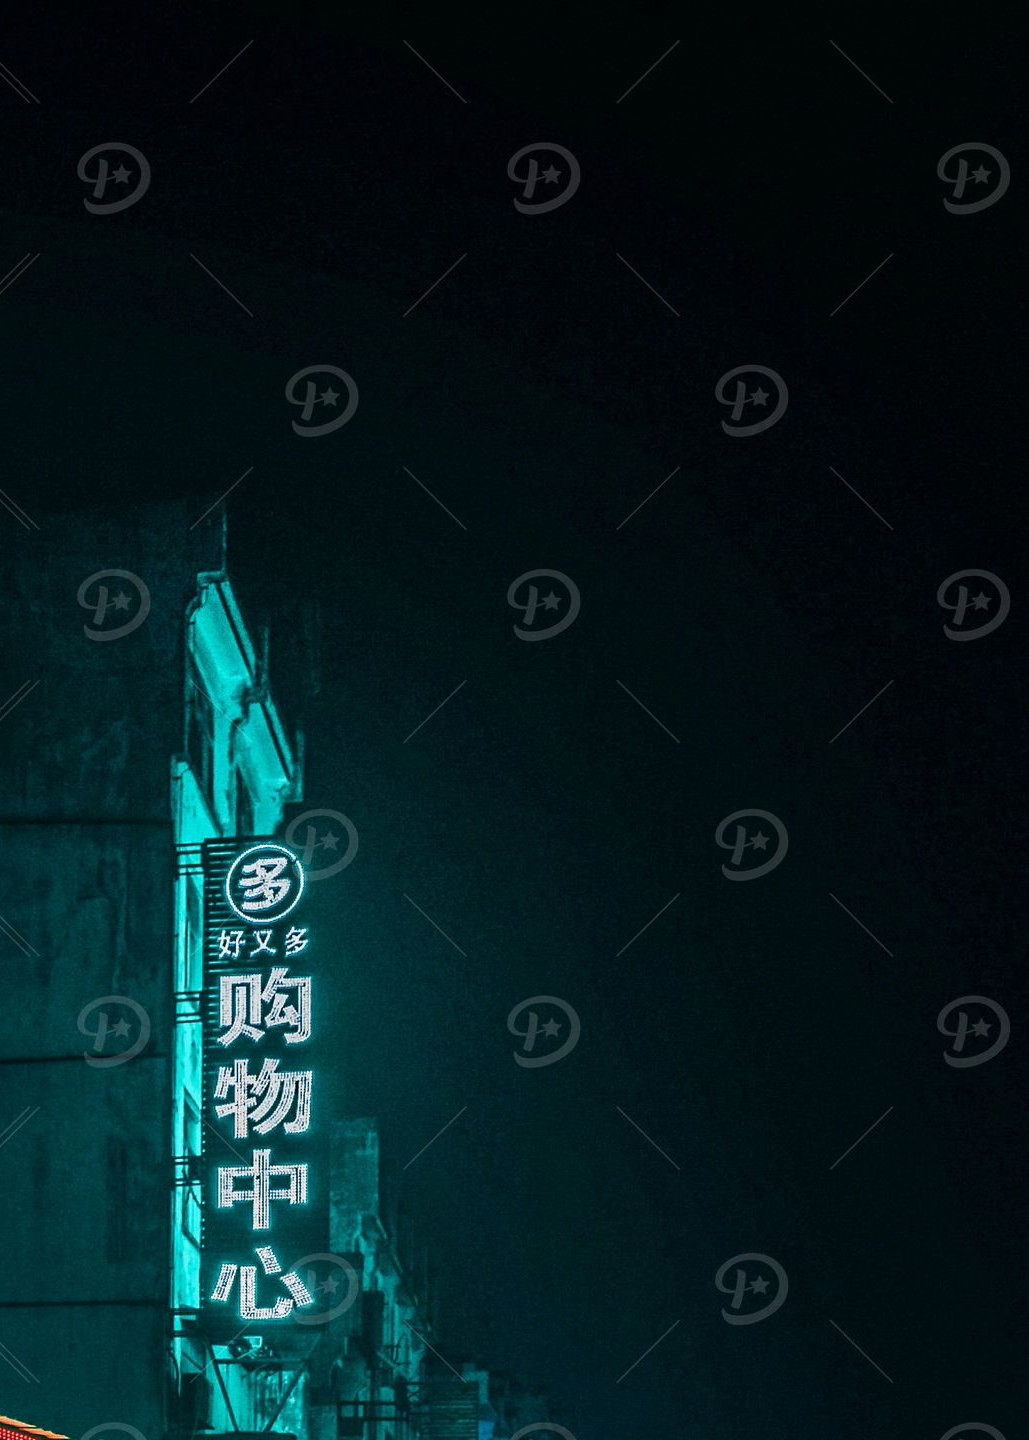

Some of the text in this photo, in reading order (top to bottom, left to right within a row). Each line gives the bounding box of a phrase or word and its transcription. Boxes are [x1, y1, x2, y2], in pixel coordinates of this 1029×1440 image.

[239, 857, 290, 911] 多
[218, 926, 309, 958] 好又多
[211, 967, 313, 1320] 购物中心
